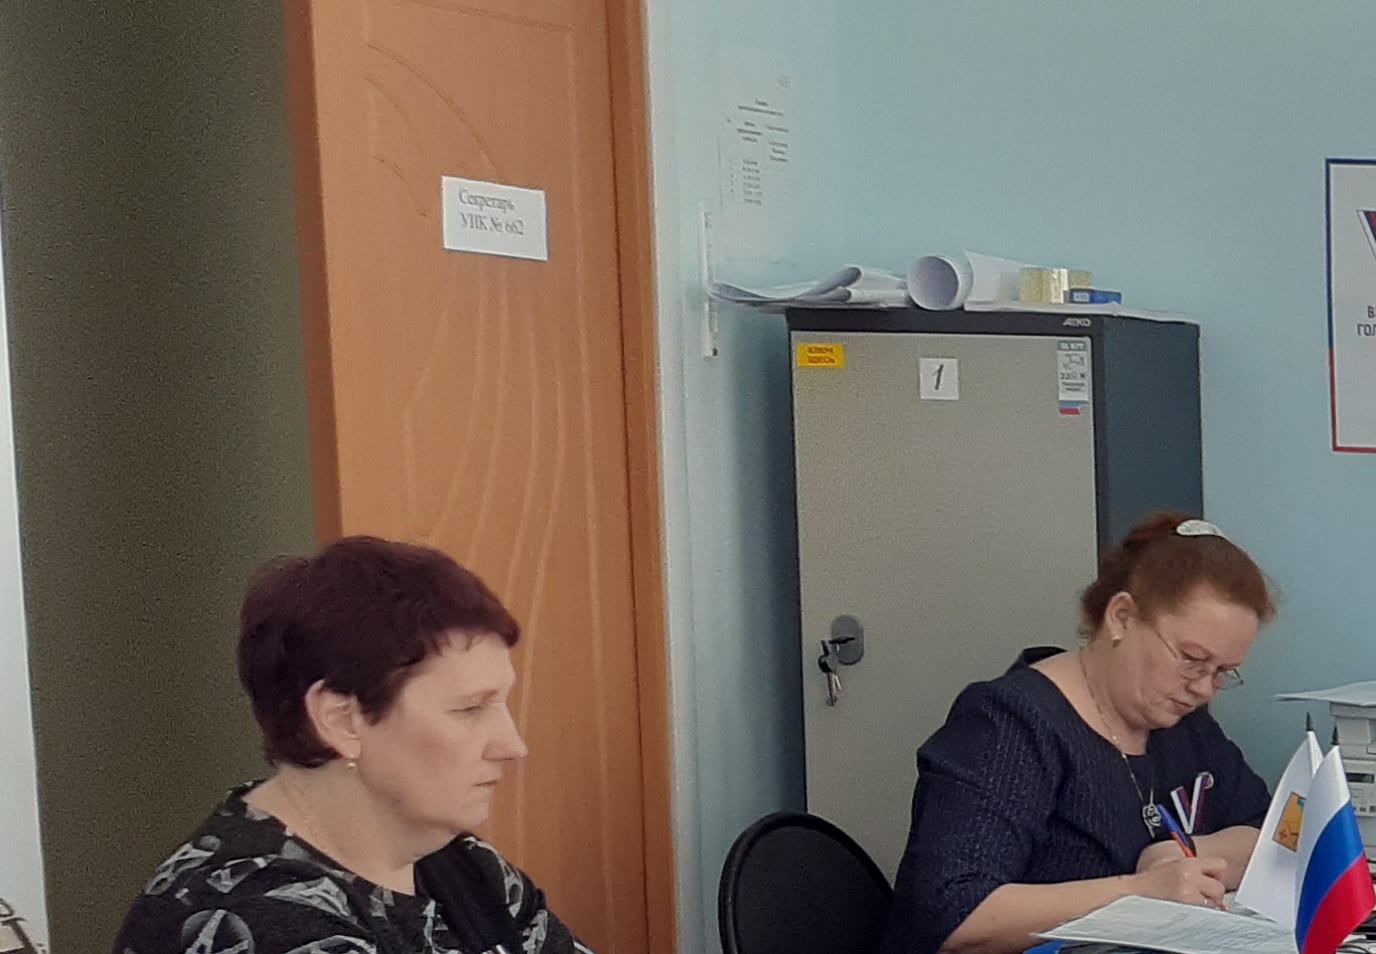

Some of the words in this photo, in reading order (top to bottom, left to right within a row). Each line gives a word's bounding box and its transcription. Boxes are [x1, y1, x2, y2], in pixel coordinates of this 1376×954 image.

[458, 188, 515, 213] Секретарь
[460, 212, 488, 231] УИК
[488, 216, 503, 233] №
[931, 364, 944, 390] 1
